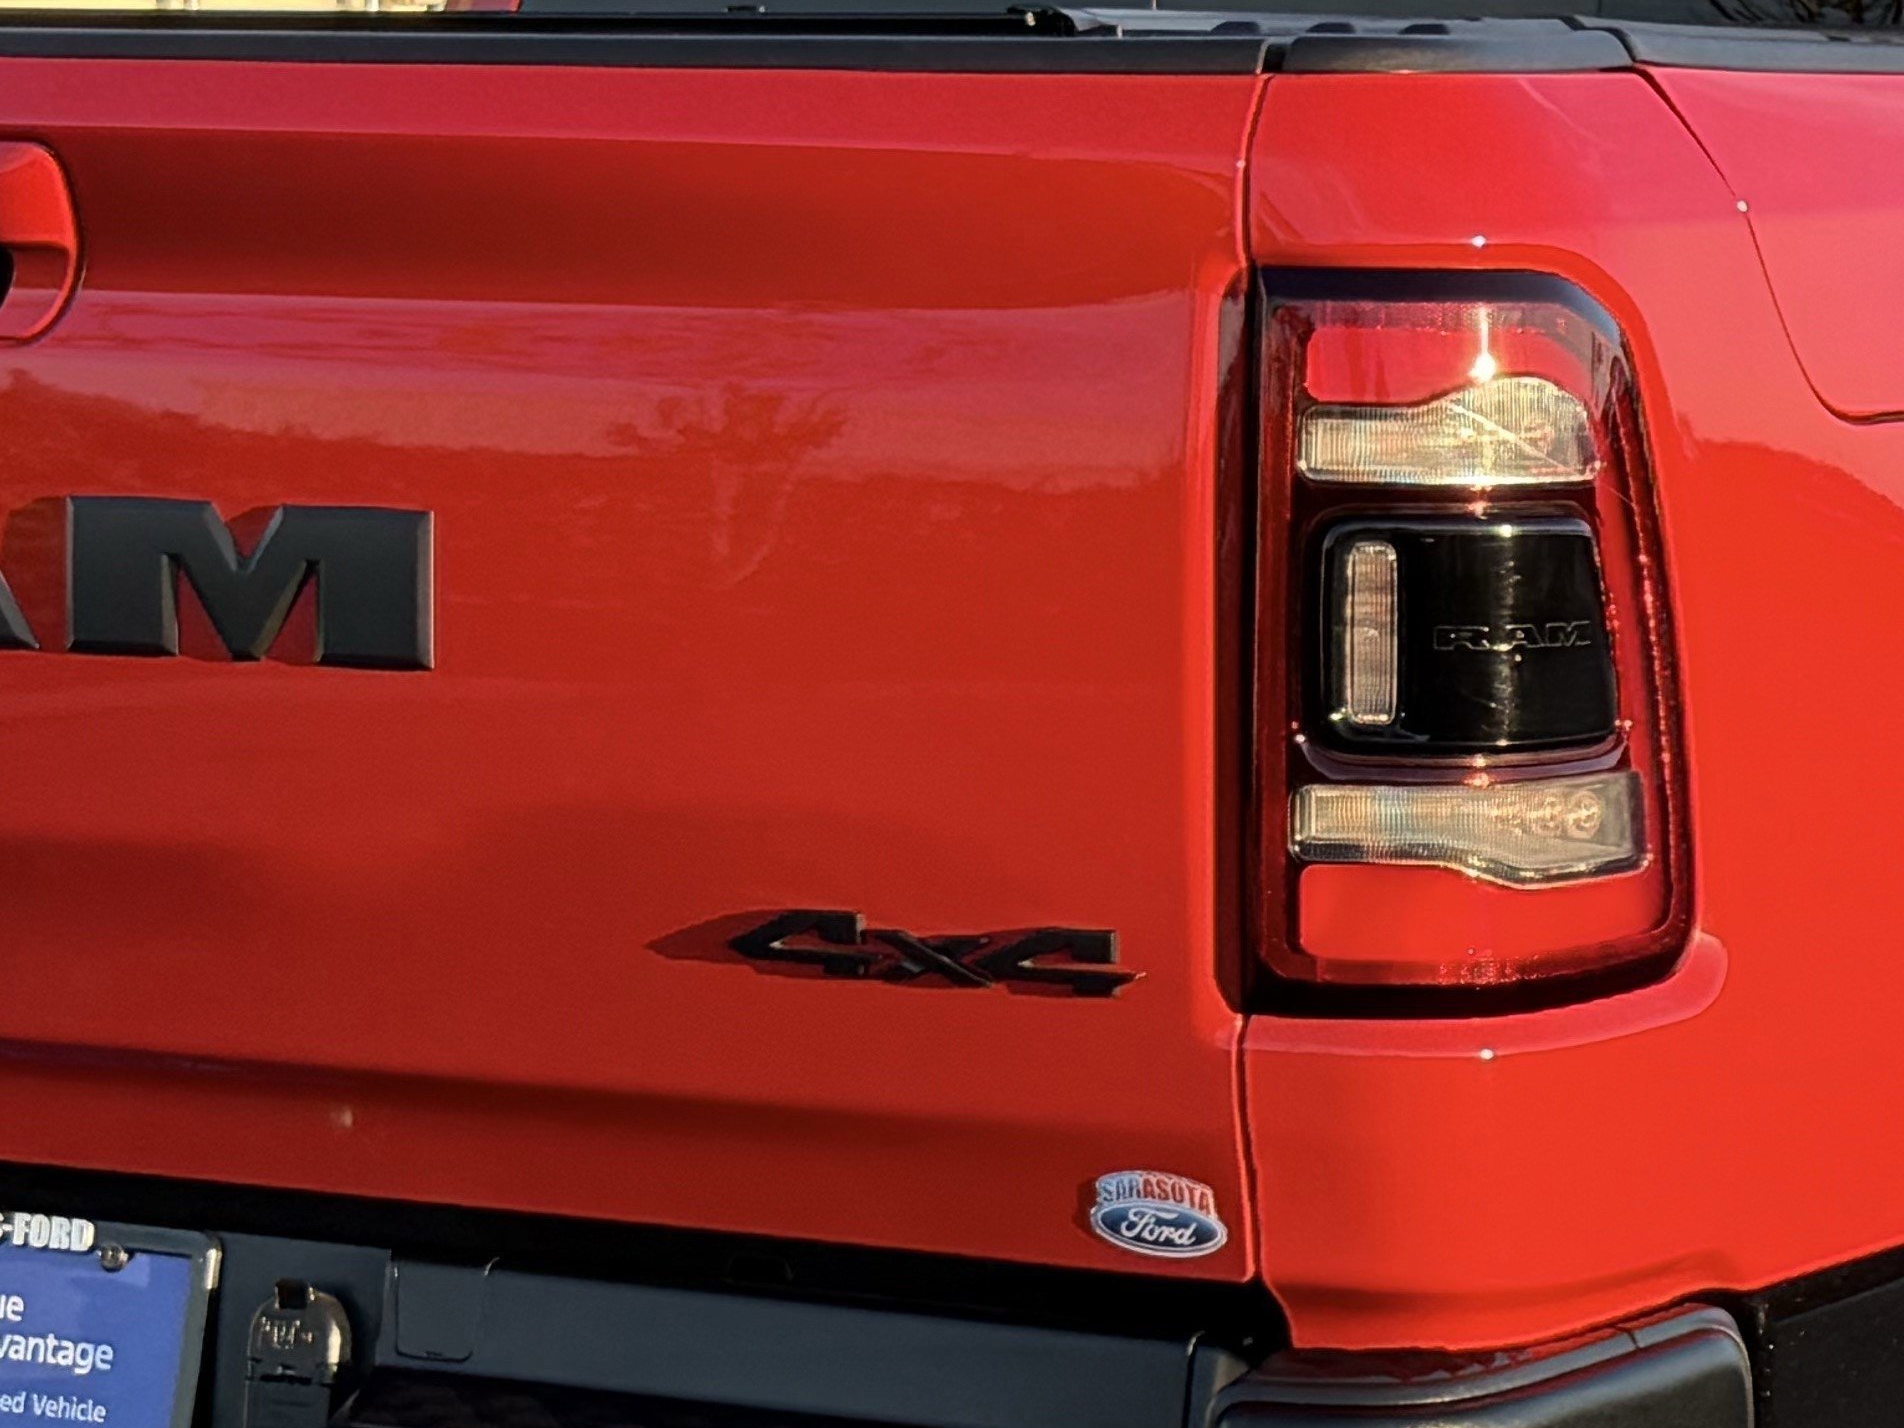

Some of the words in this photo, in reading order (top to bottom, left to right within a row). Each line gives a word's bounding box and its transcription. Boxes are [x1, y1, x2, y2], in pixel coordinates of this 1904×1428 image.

[1434, 620, 1591, 651] RAM
[1100, 1176, 1212, 1217] SARASOTA
[1120, 1207, 1197, 1245] Ford
[33, 1392, 107, 1424] Vehicle
